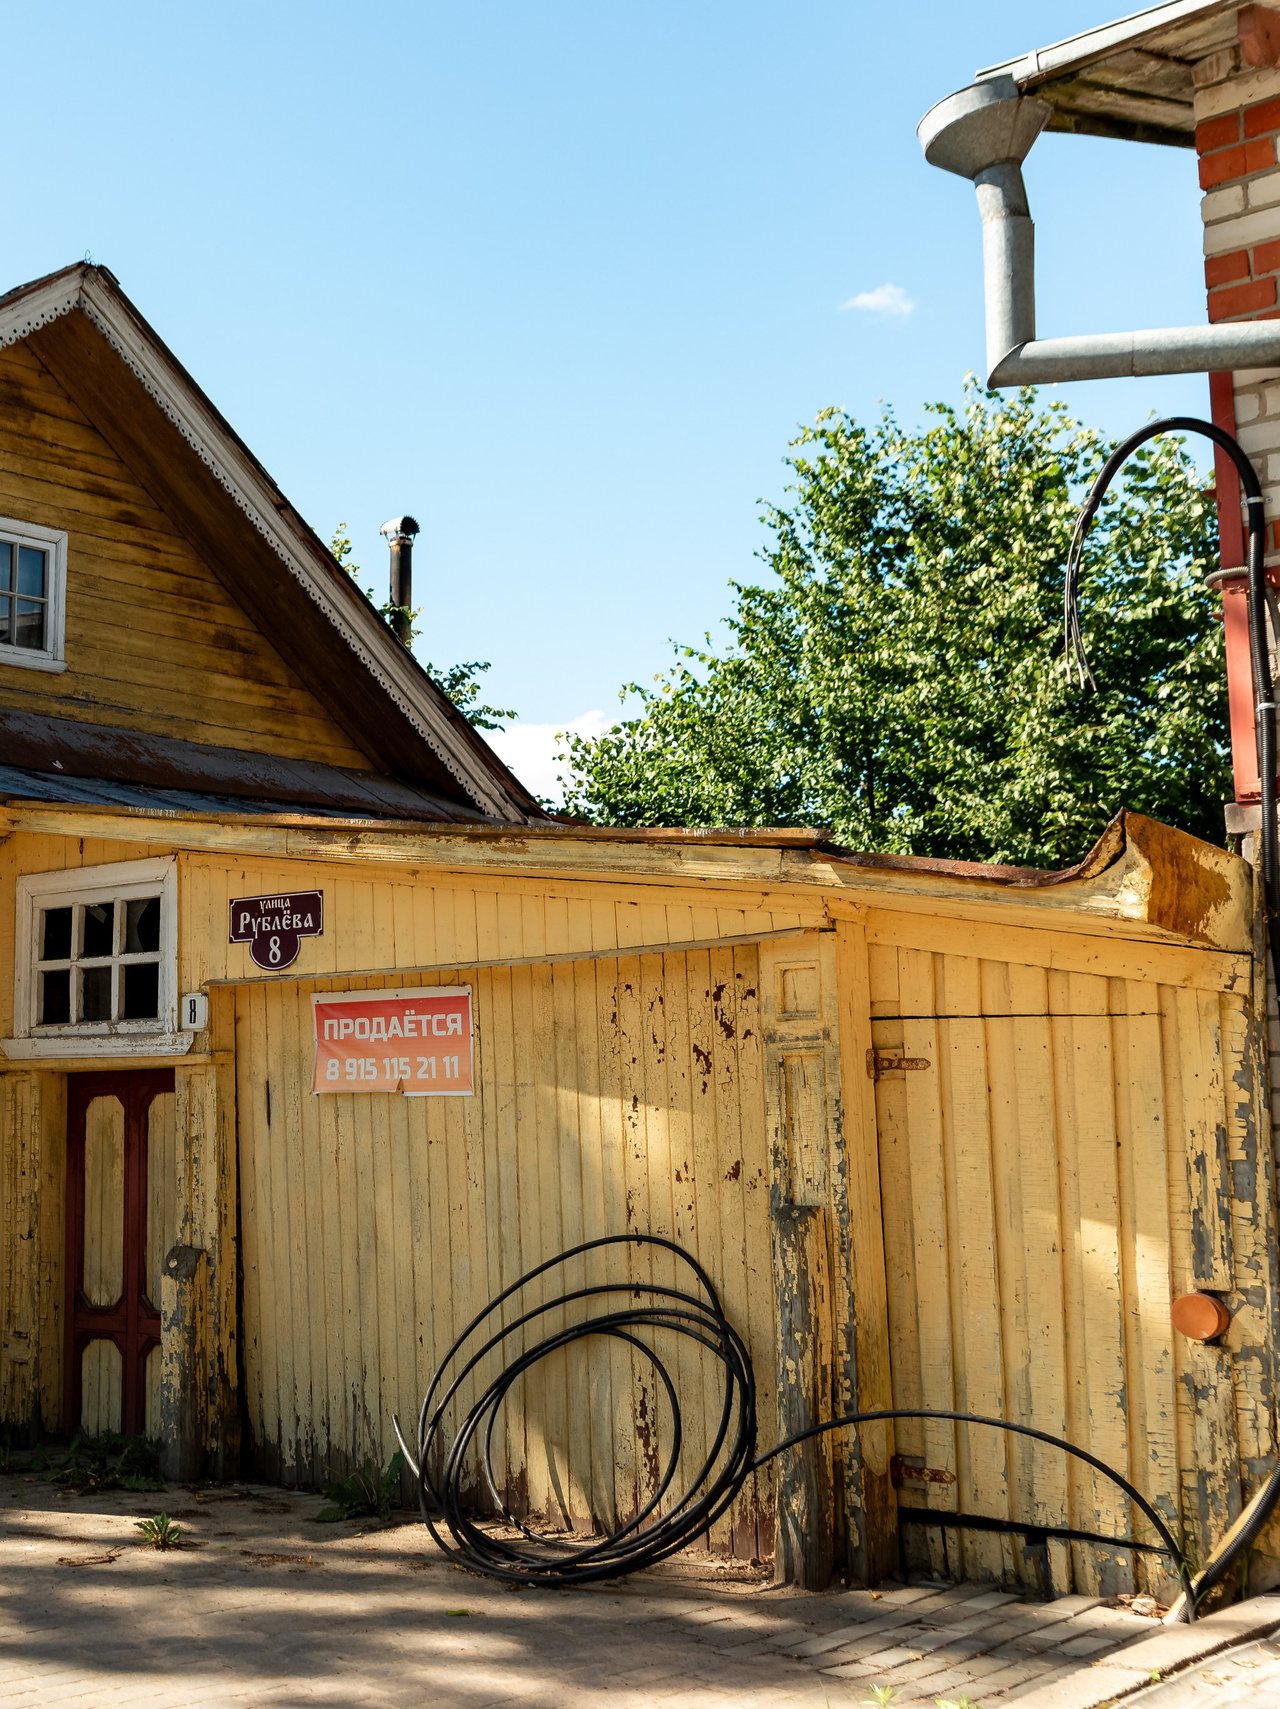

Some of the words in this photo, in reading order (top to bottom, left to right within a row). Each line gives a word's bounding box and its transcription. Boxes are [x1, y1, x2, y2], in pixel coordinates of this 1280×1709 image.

[268, 935, 281, 964] 8
[189, 999, 197, 1024] 8
[324, 1009, 463, 1043] ПРОДАЁТСЯ
[325, 1058, 340, 1081] 8
[345, 1057, 378, 1080] 915
[382, 1056, 412, 1080] 115
[416, 1056, 437, 1079] 21
[442, 1055, 459, 1079] 11
